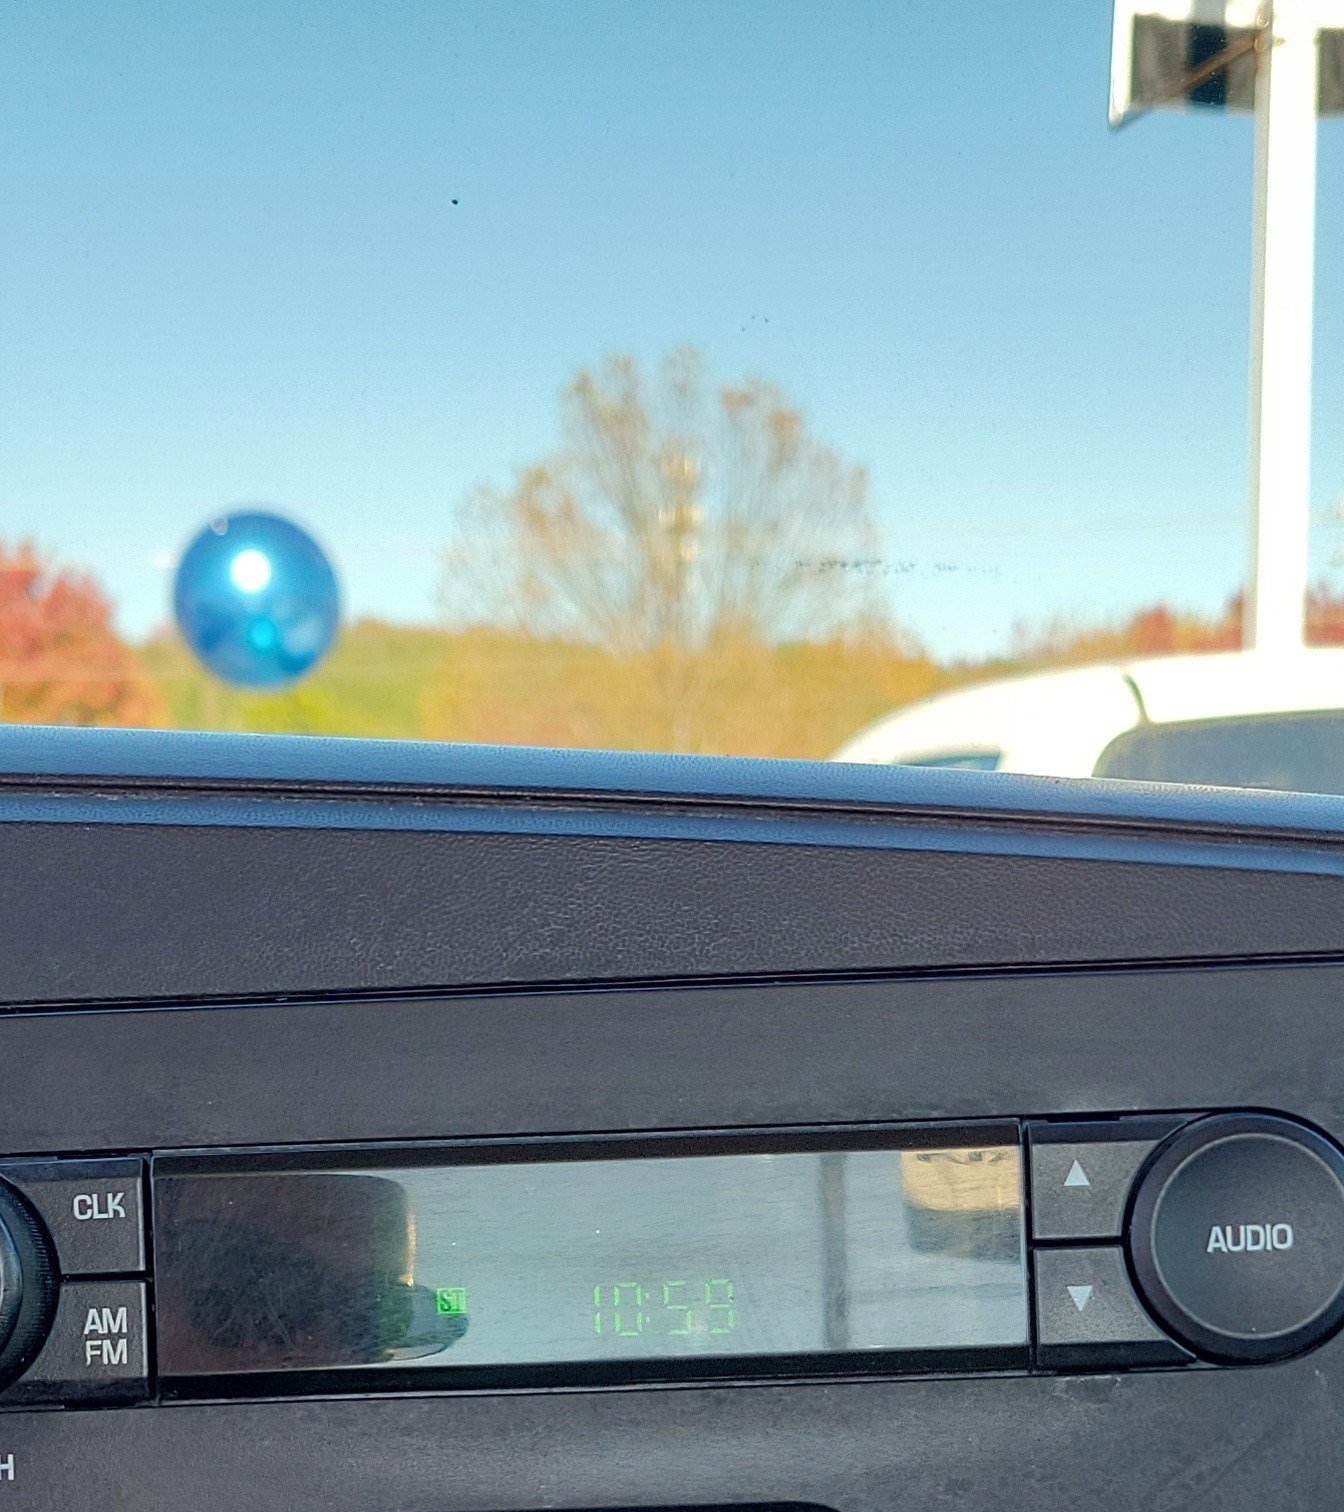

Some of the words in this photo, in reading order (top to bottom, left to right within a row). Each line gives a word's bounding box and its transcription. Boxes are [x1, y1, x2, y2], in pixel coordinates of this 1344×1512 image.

[73, 1192, 126, 1220] CLK
[1206, 1223, 1294, 1253] AUDIO
[83, 1306, 128, 1335] AM
[85, 1338, 128, 1366] FM
